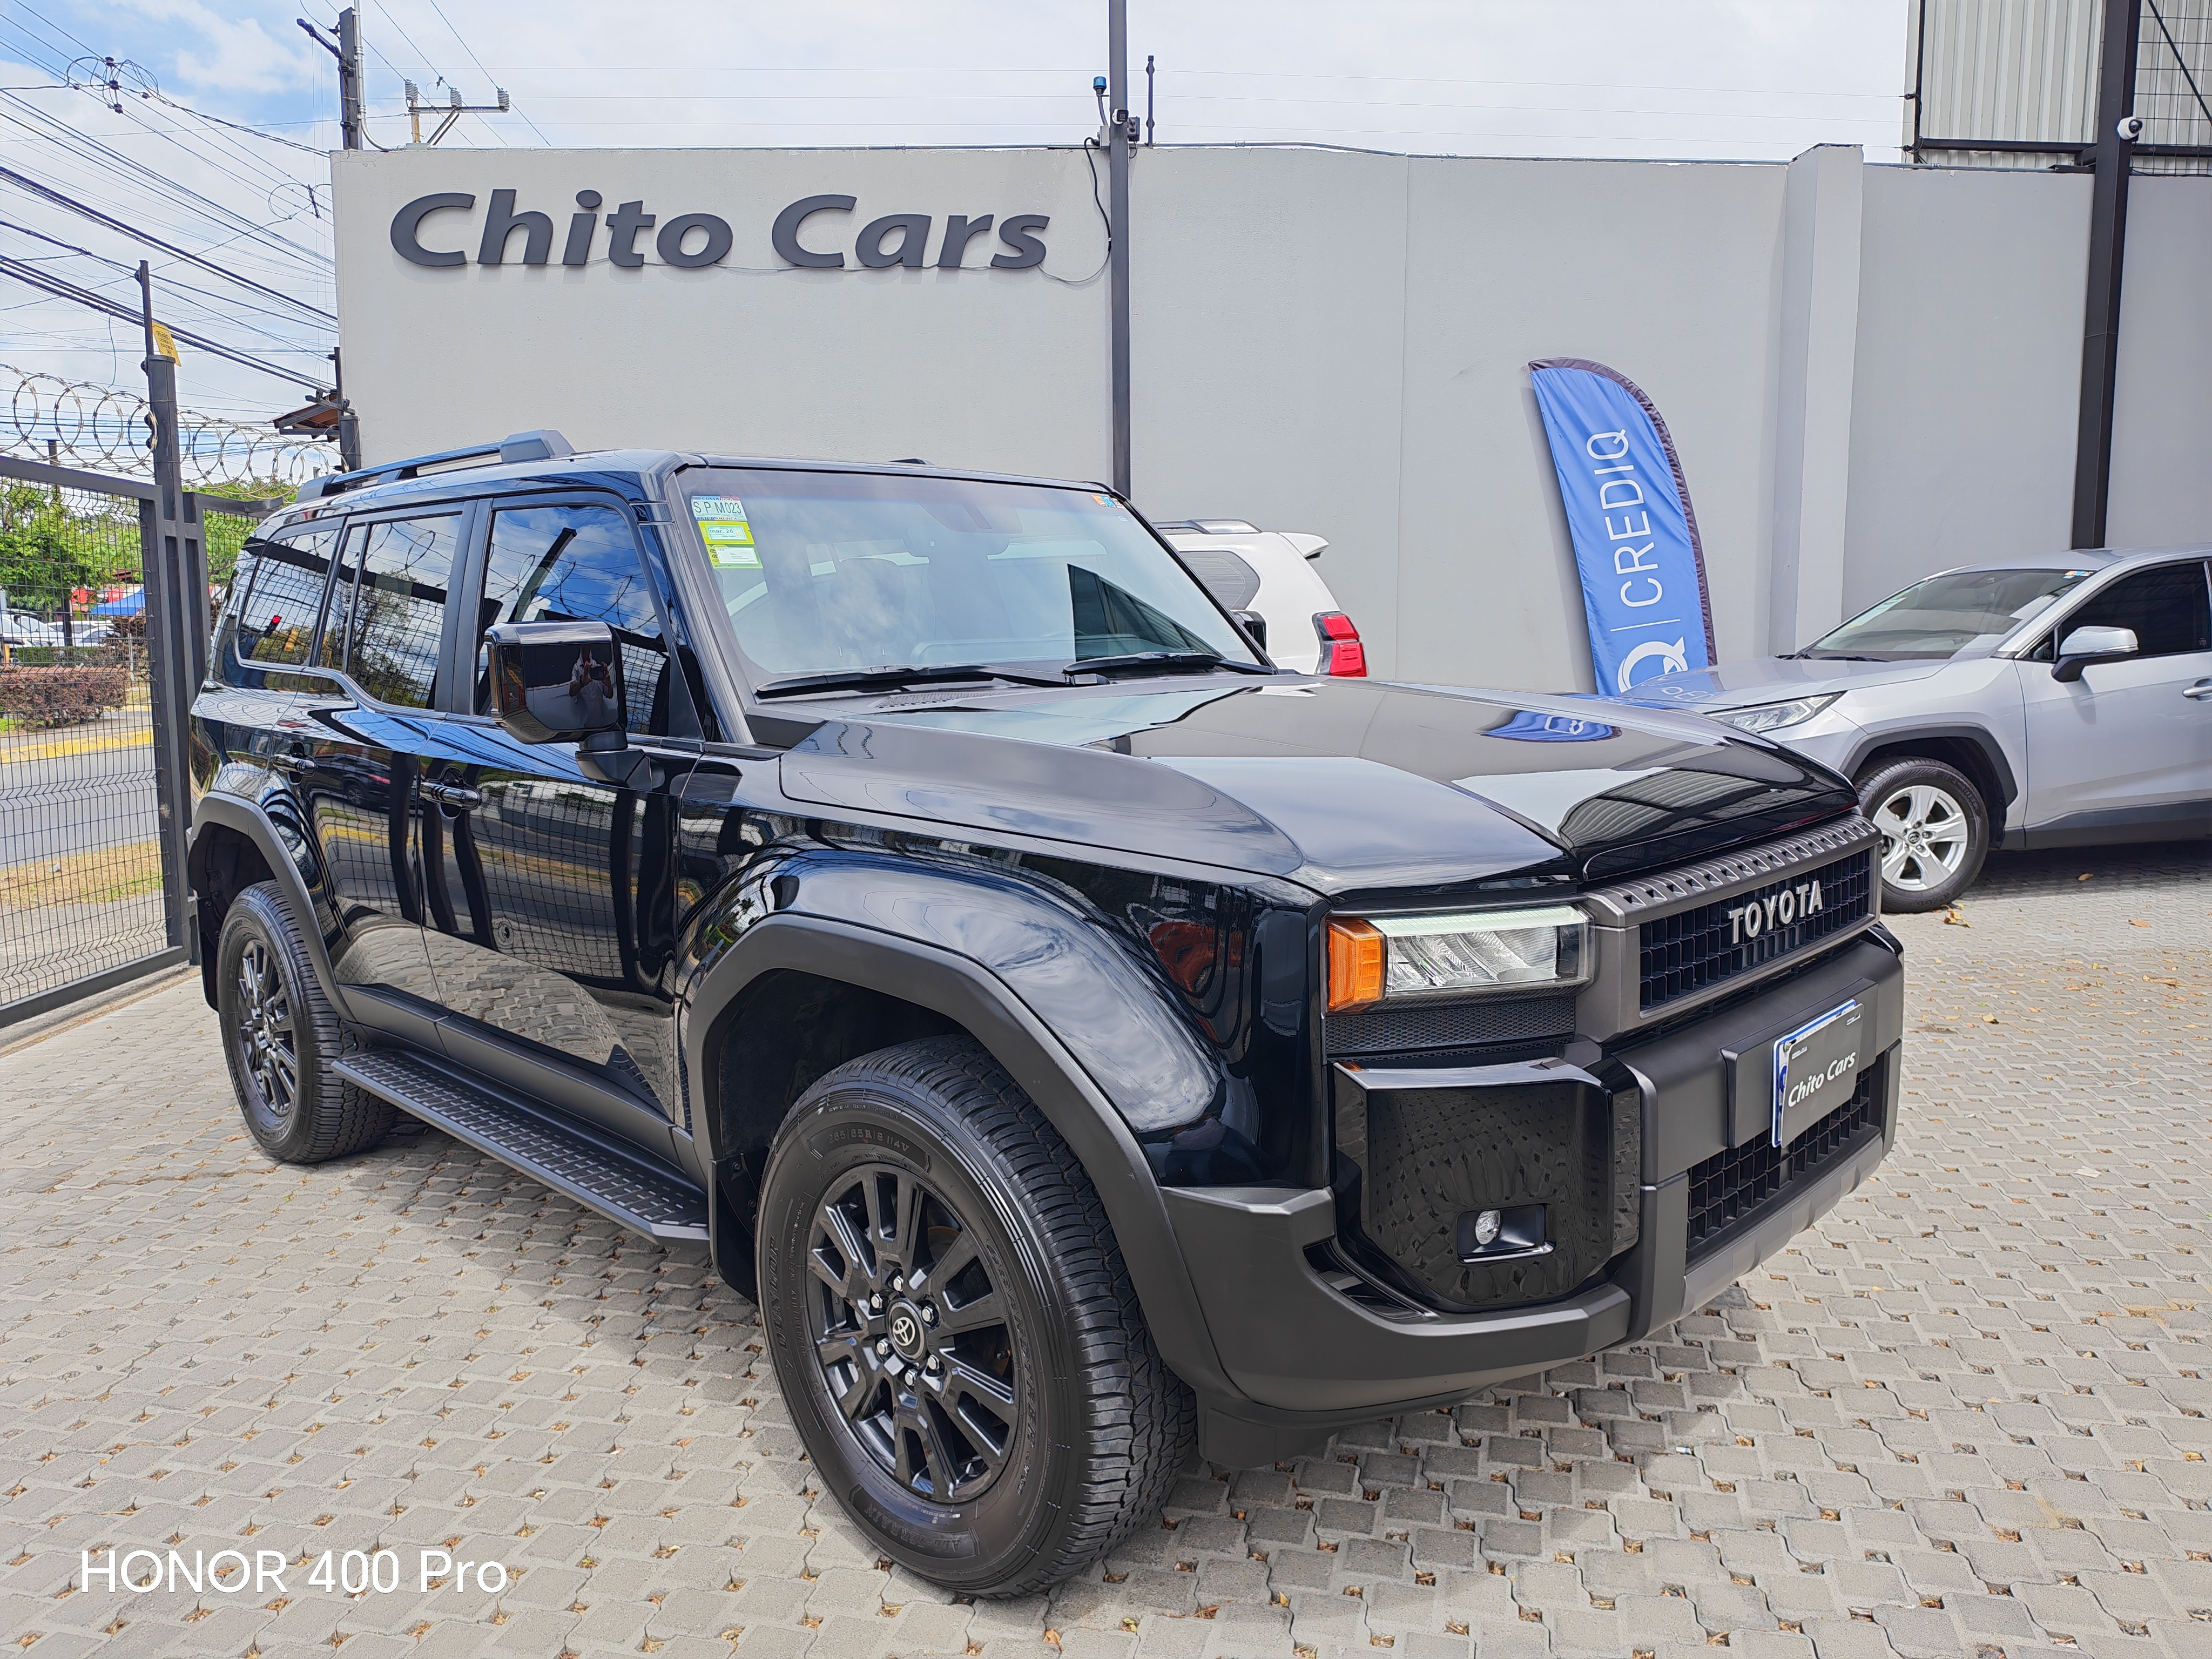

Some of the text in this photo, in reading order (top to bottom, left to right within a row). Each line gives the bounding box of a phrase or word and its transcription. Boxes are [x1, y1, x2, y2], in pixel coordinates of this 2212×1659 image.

[390, 188, 1051, 269] Chito Cars
[1586, 429, 1663, 608] CREDIQ
[1728, 880, 1823, 945] TOYOTA
[1788, 1051, 1856, 1108] Chito Cars
